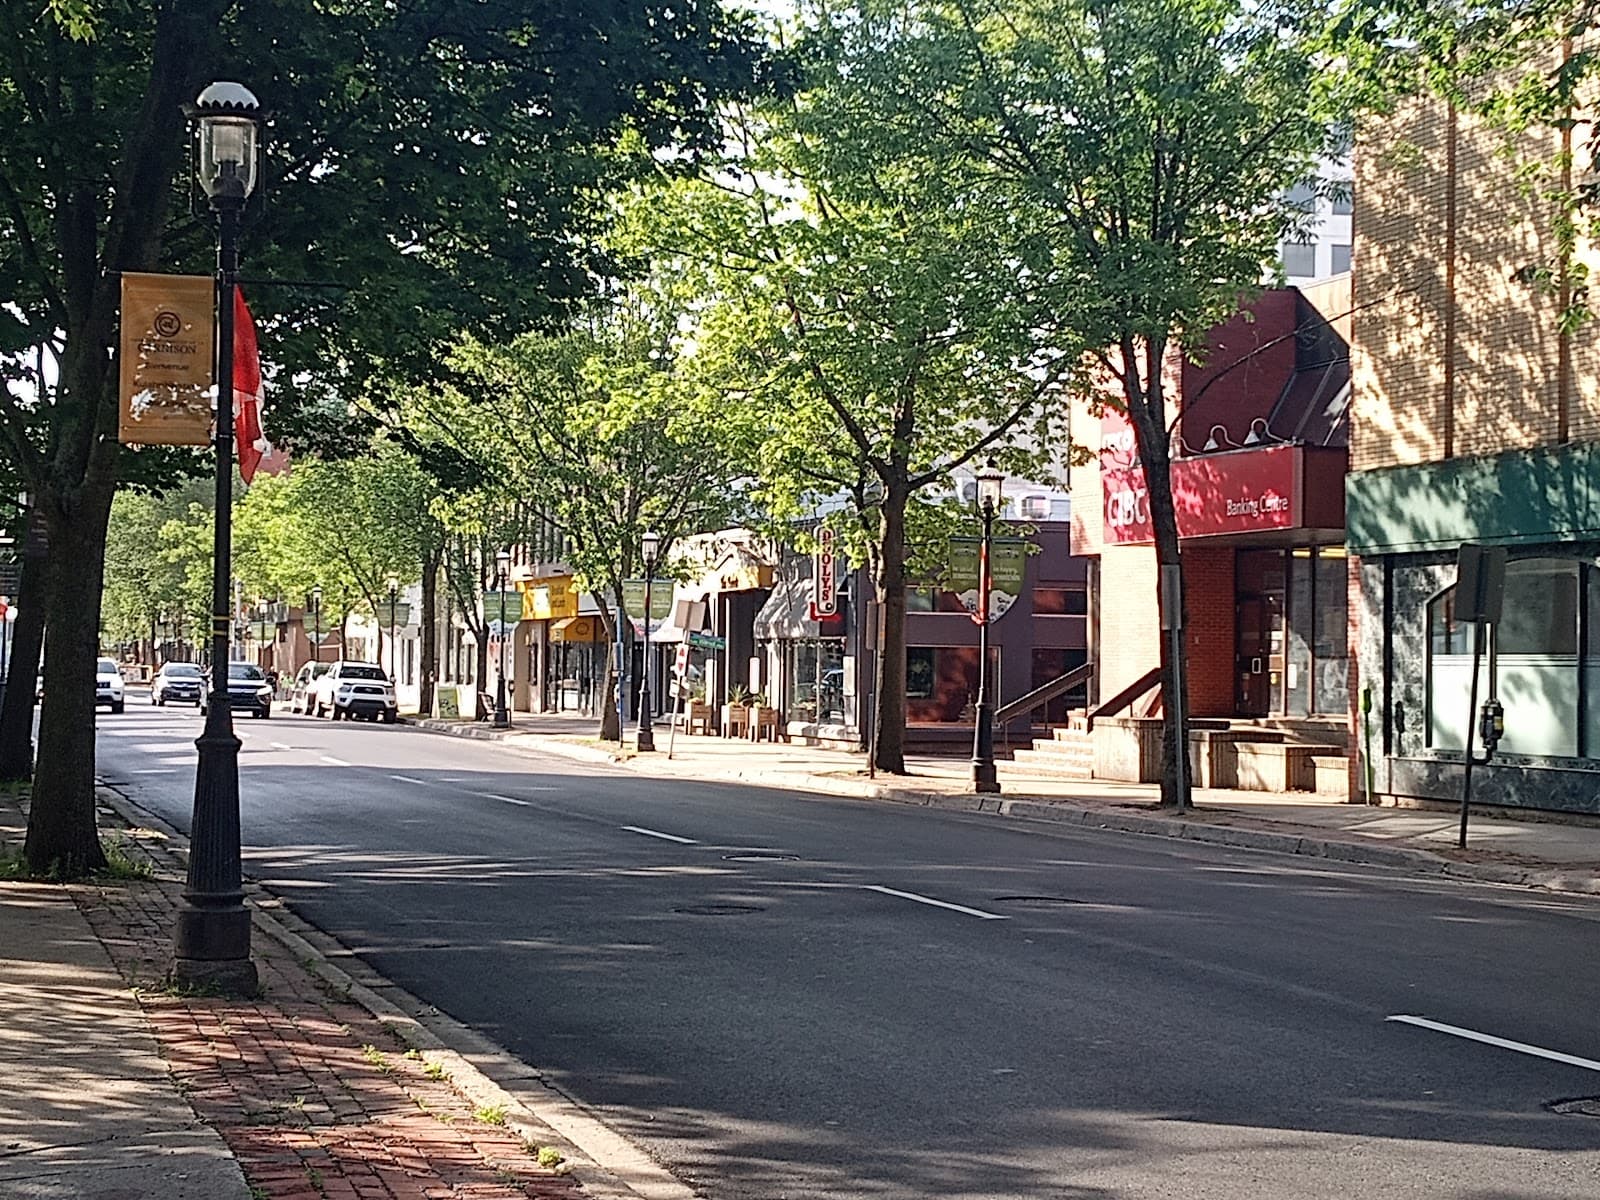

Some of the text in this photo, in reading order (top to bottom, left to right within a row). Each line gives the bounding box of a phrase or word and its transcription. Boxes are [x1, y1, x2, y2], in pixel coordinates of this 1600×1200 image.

[1108, 488, 1146, 528] CIBC
[1226, 494, 1289, 517] Banking Centre
